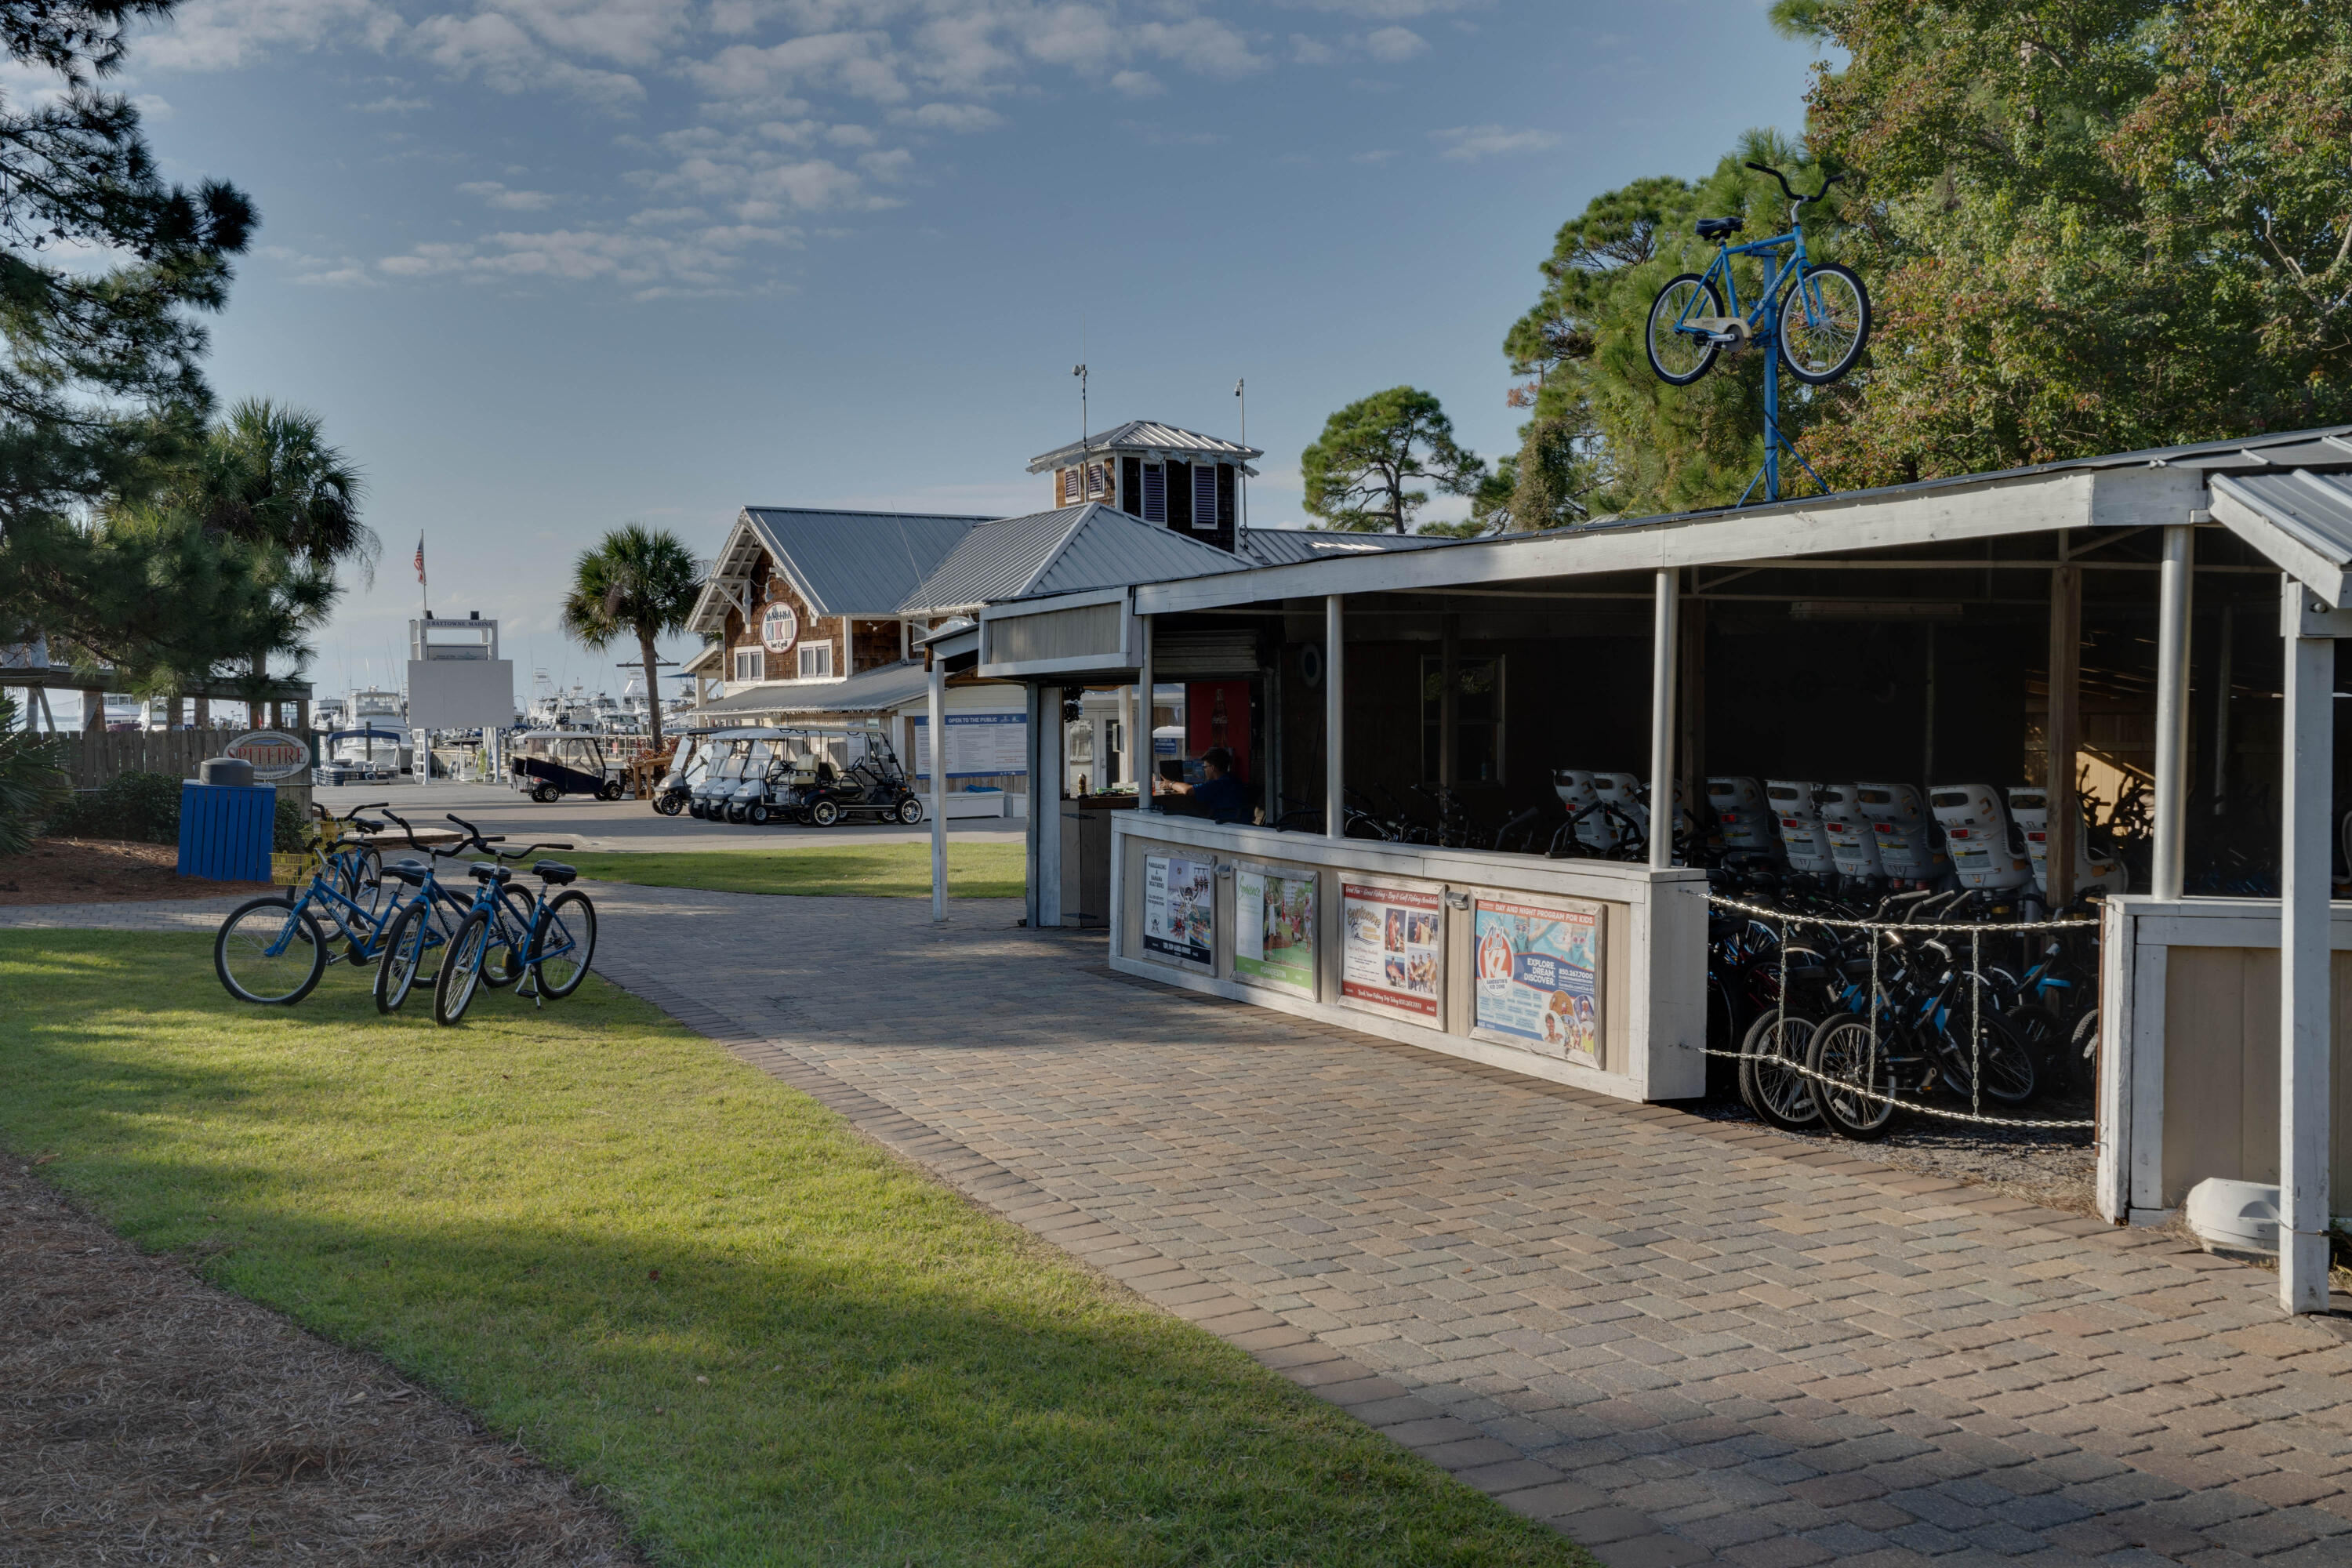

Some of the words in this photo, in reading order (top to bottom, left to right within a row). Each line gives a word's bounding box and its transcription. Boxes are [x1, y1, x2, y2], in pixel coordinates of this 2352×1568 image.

[227, 746, 306, 764] SPITFIRE
[1537, 909, 1565, 920] PROGRAM
[1566, 913, 1578, 922] FOR
[1579, 915, 1593, 924] KIDS
[1483, 949, 1508, 980] KZ
[1527, 957, 1556, 970] EXPLORE.
[1523, 973, 1556, 986] DISCOVER.
[1532, 967, 1555, 978] DREAM.
